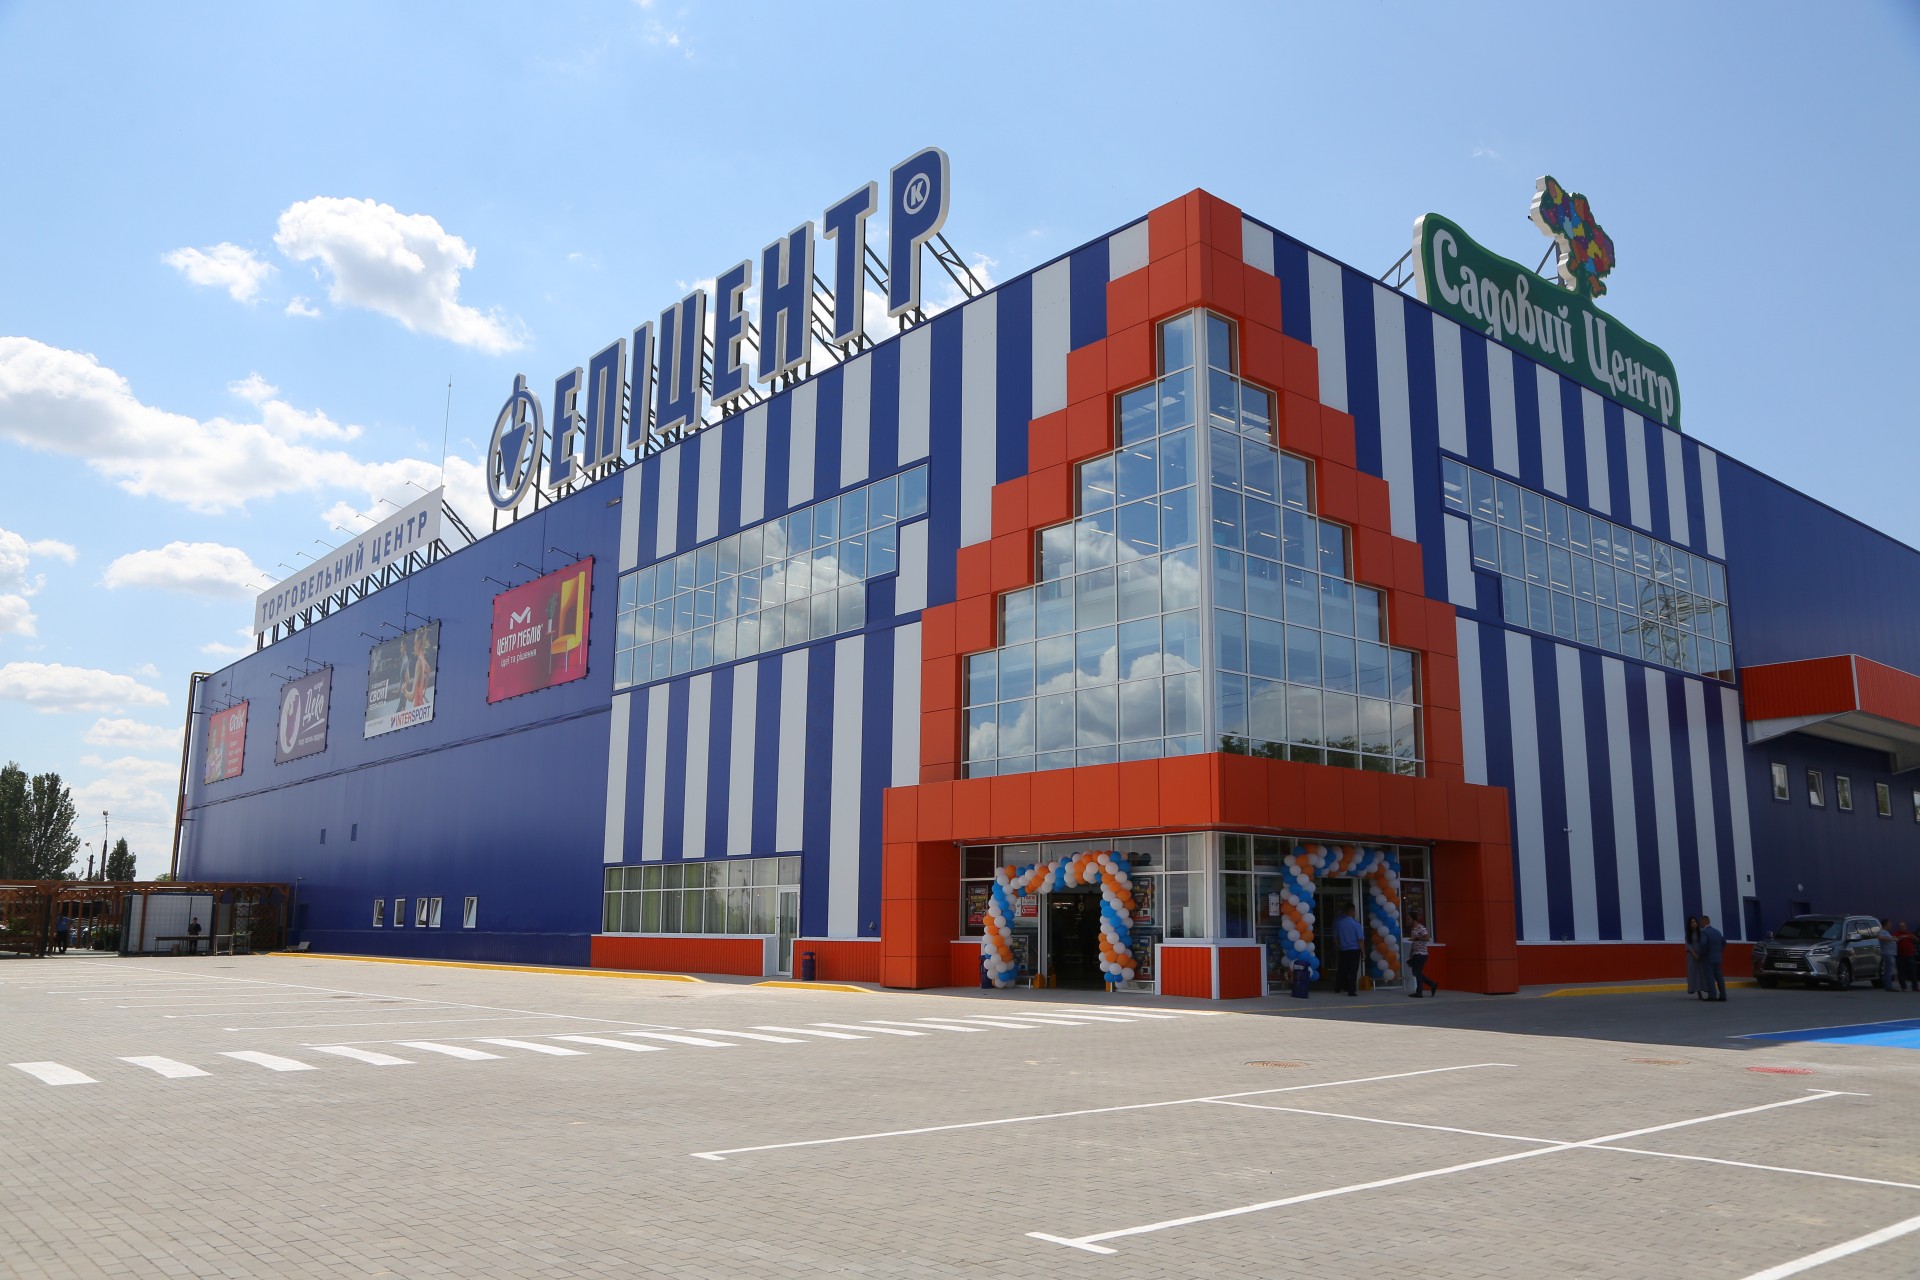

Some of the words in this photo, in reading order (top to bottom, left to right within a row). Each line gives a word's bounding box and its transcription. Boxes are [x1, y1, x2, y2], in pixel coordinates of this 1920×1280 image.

[548, 146, 950, 490] ЕПІЦЕНТР
[1433, 228, 1574, 364] Садовий
[1582, 309, 1674, 425] Центр
[262, 541, 364, 624] ТОРГОВЕЛЬНИЙ
[371, 510, 428, 565] ЦЕНТР
[496, 633, 517, 656] ЦЕНТР
[517, 624, 542, 649] МЕБЛІВ
[395, 705, 431, 728] INTERSPORT
